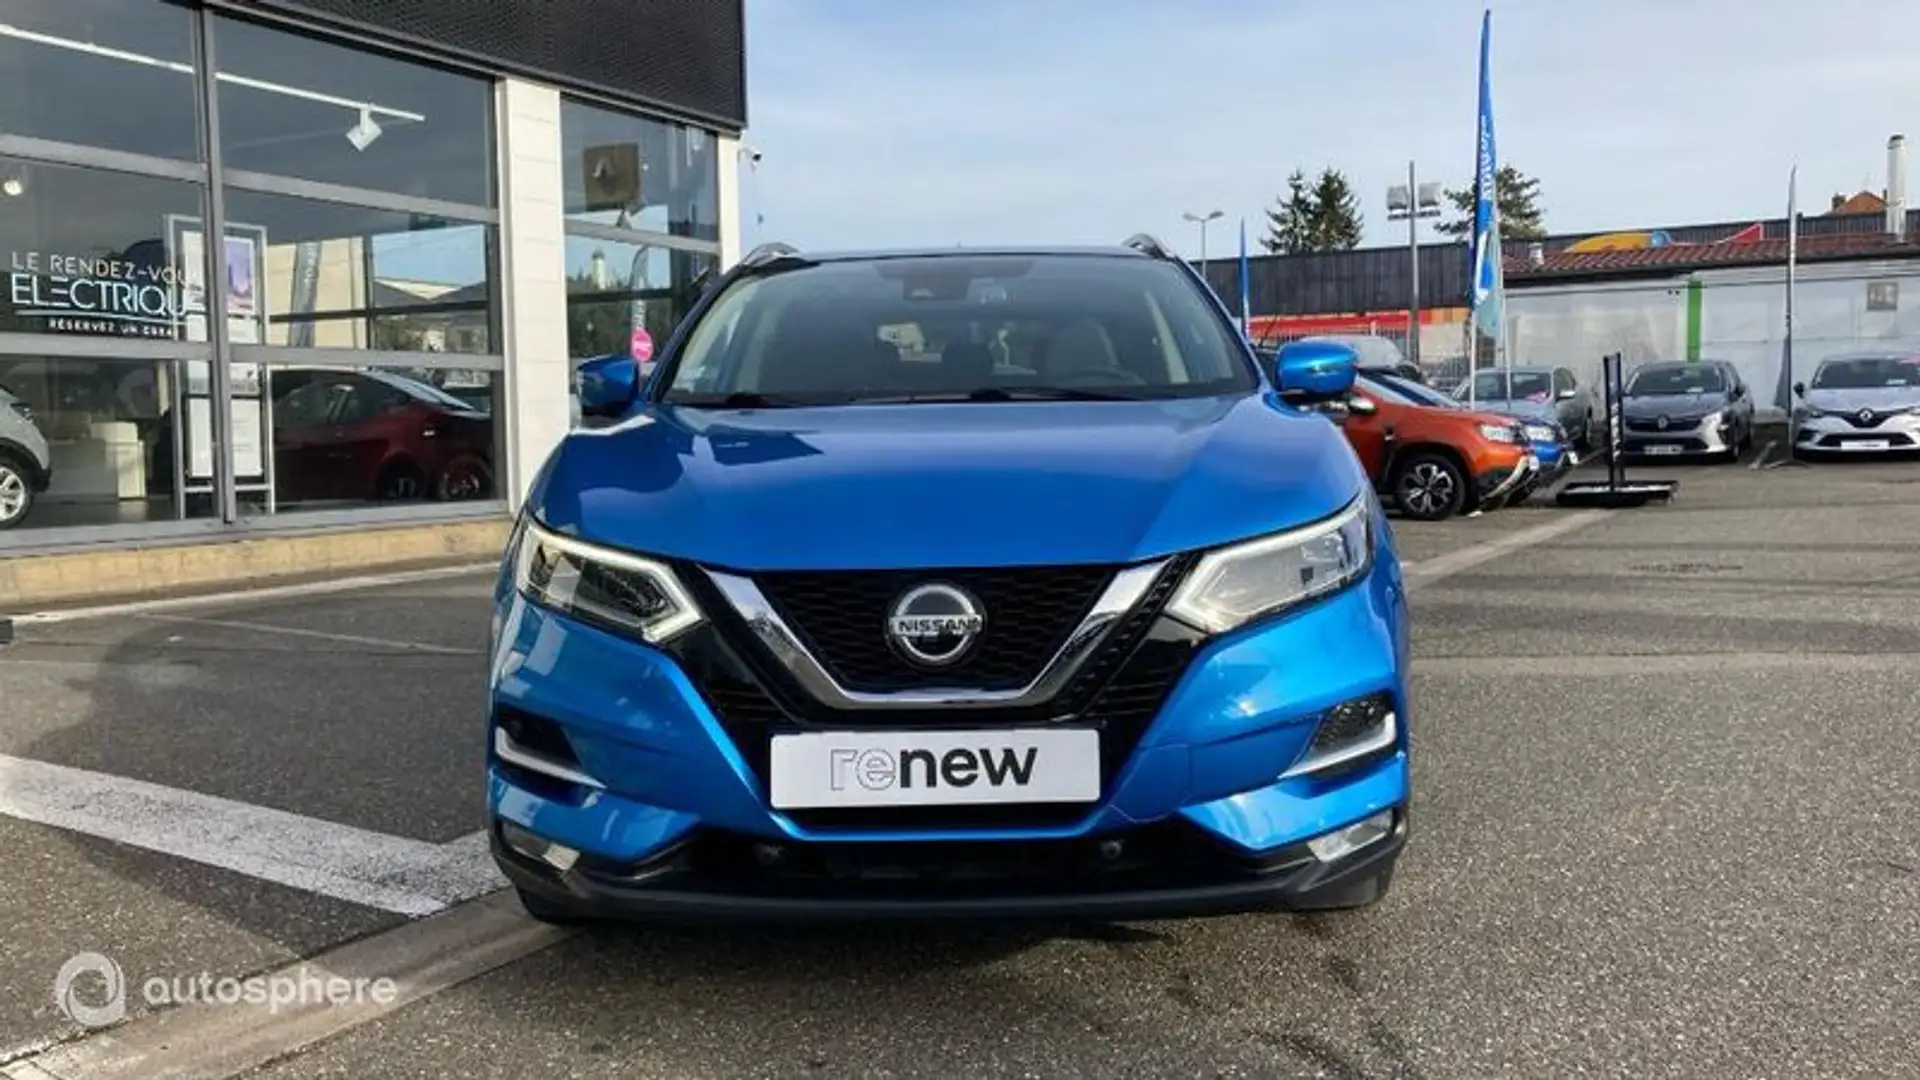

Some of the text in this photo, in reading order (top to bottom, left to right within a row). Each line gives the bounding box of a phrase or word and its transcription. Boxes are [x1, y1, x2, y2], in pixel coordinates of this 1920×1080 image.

[11, 251, 198, 288] LE RENDEZ-VOU
[899, 618, 981, 633] NISSAN
[830, 745, 1038, 791] renew
